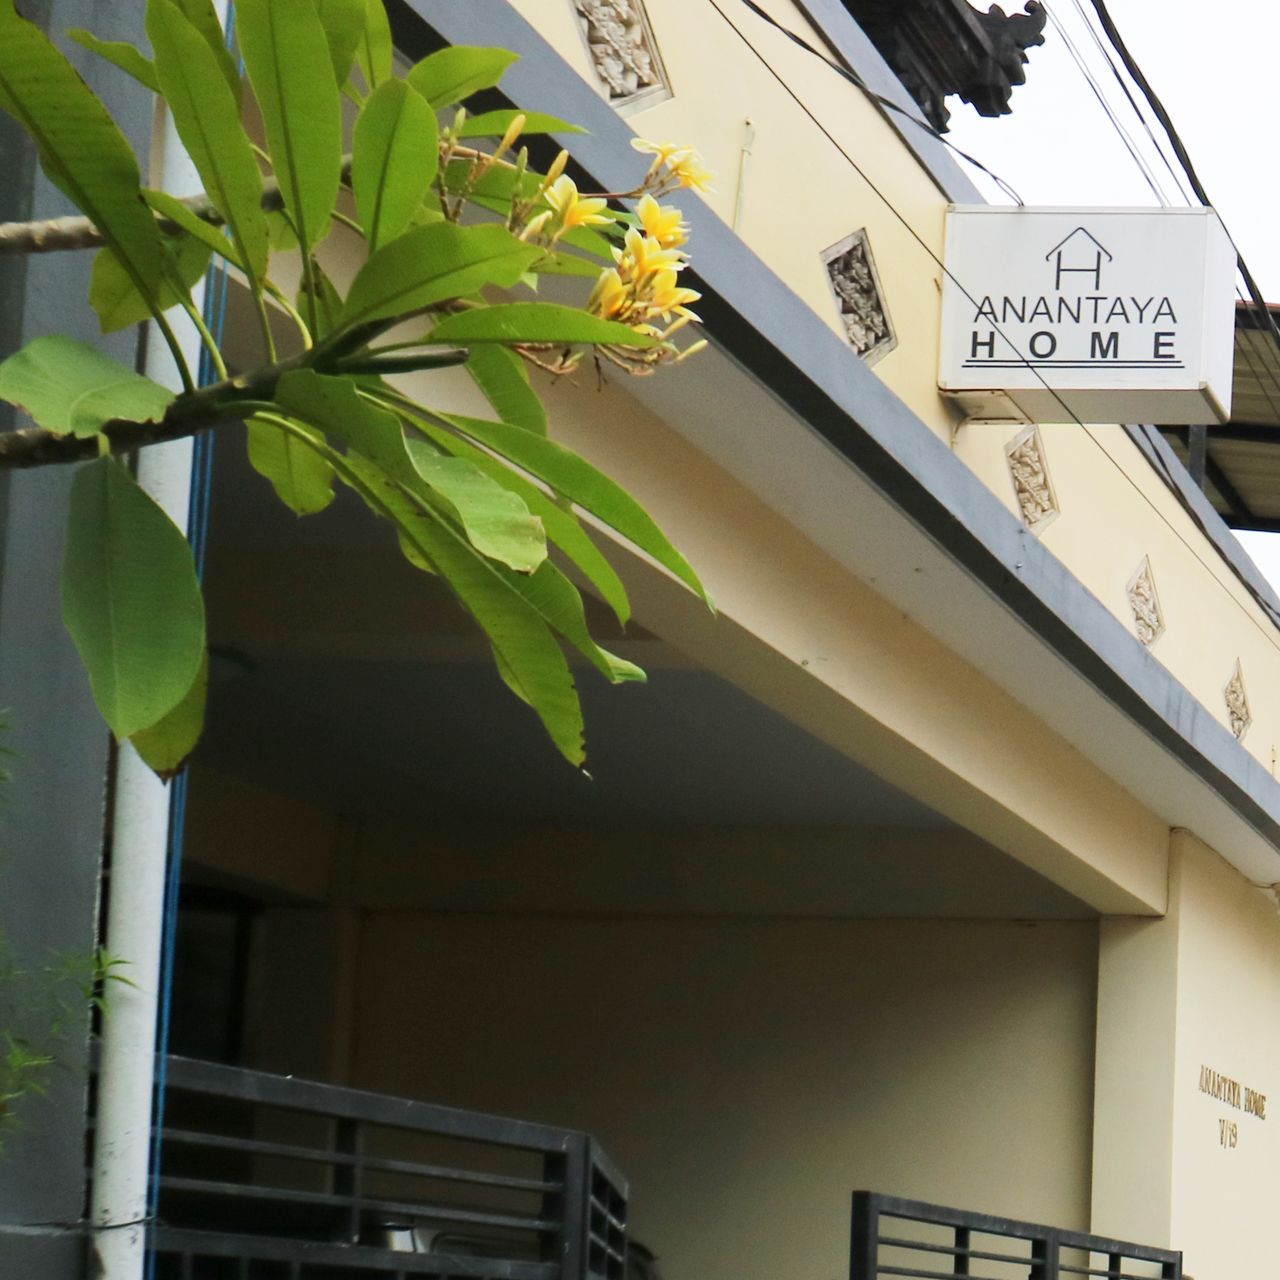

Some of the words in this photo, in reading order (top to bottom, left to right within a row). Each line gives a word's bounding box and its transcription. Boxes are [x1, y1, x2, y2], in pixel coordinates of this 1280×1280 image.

[973, 296, 1178, 324] ANANTAYA
[971, 331, 1176, 359] HOME
[1198, 1064, 1241, 1110] ANANTAYA
[1244, 1086, 1266, 1120] HOME
